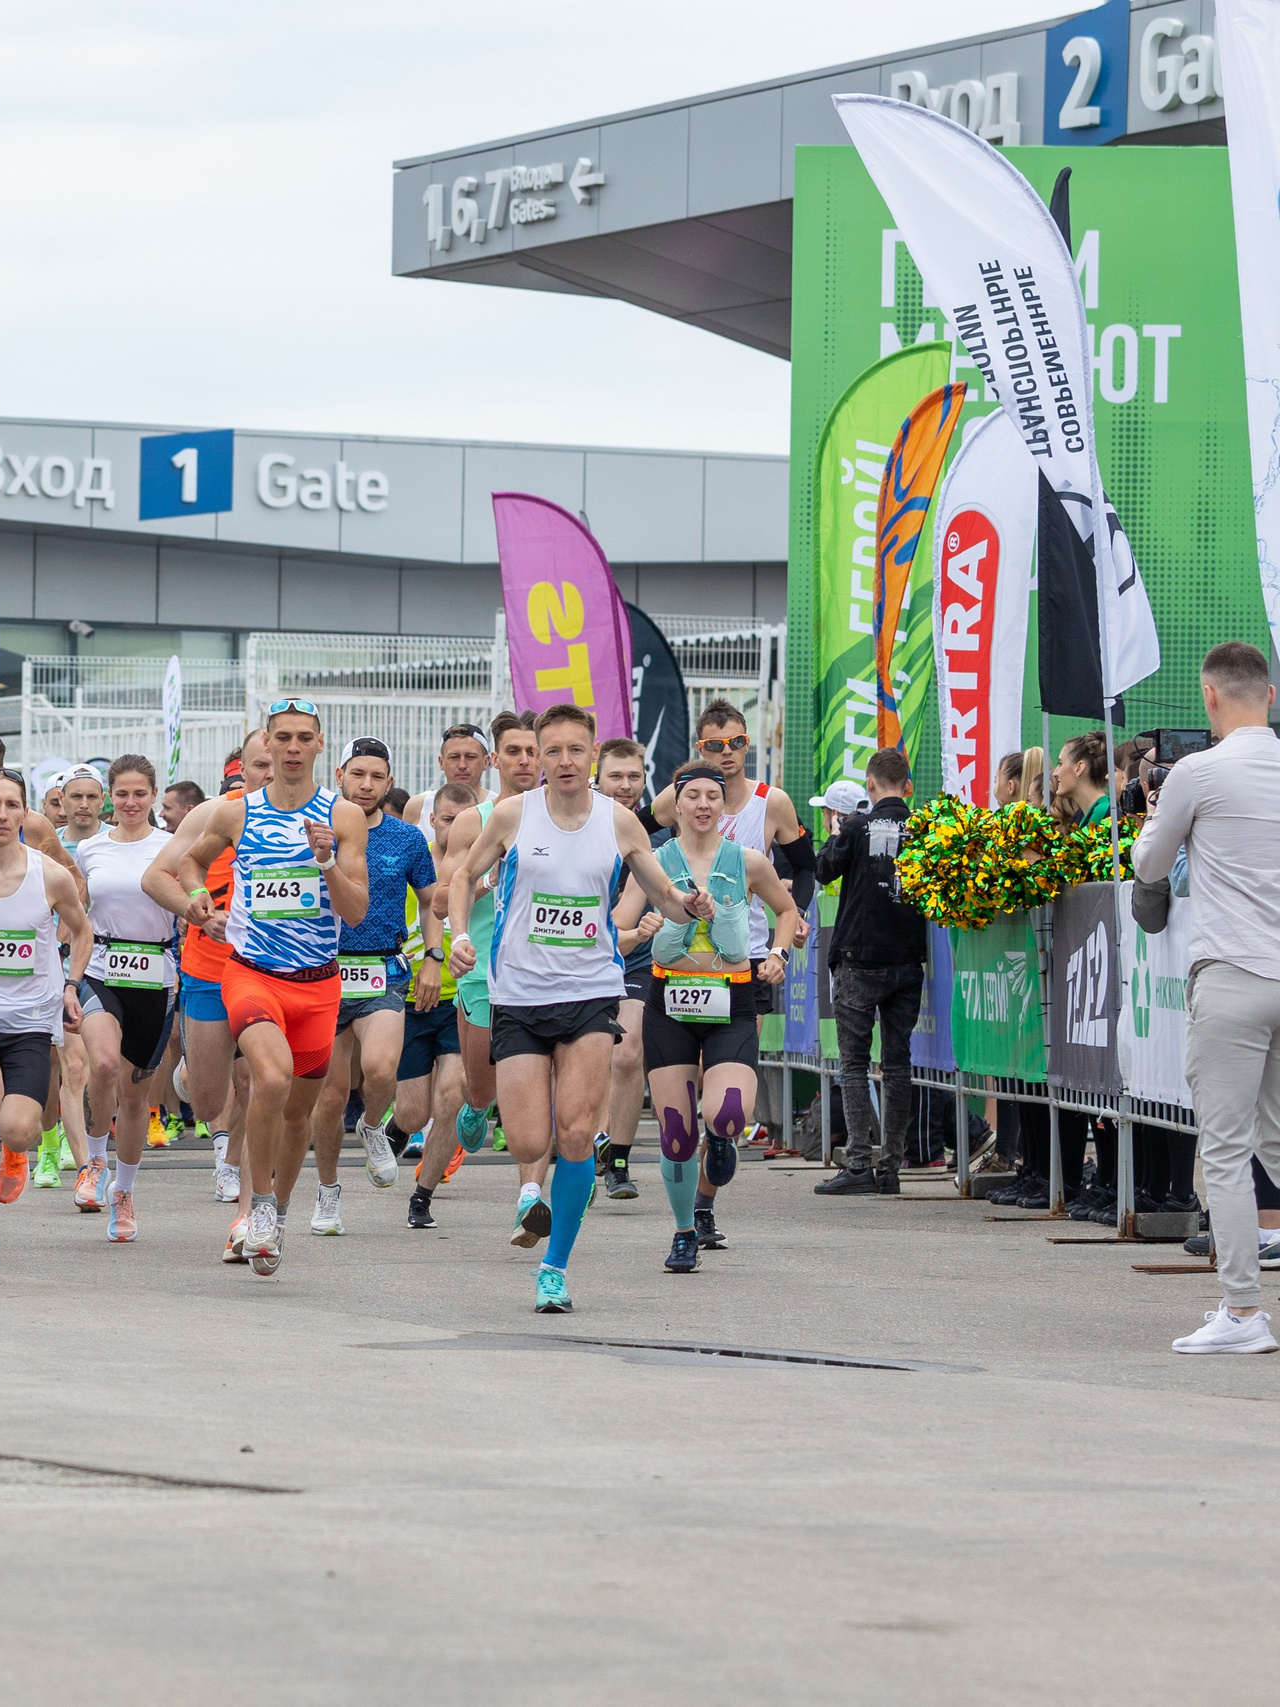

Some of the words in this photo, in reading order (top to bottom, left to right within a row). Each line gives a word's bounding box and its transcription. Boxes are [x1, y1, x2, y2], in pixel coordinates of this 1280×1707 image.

[1059, 36, 1102, 130] 2
[1139, 17, 1225, 114] Ga
[509, 198, 556, 225] Gates
[171, 447, 199, 503] 1
[256, 453, 390, 512] Gate
[255, 881, 301, 898] 2463
[535, 907, 583, 926] 0768
[533, 926, 565, 935] ДМИТРИЙ
[585, 925, 595, 936] A
[20, 946, 30, 956] A
[109, 954, 149, 971] 0940
[341, 968, 369, 982] 055
[372, 977, 382, 988] A
[669, 989, 712, 1005] 1297
